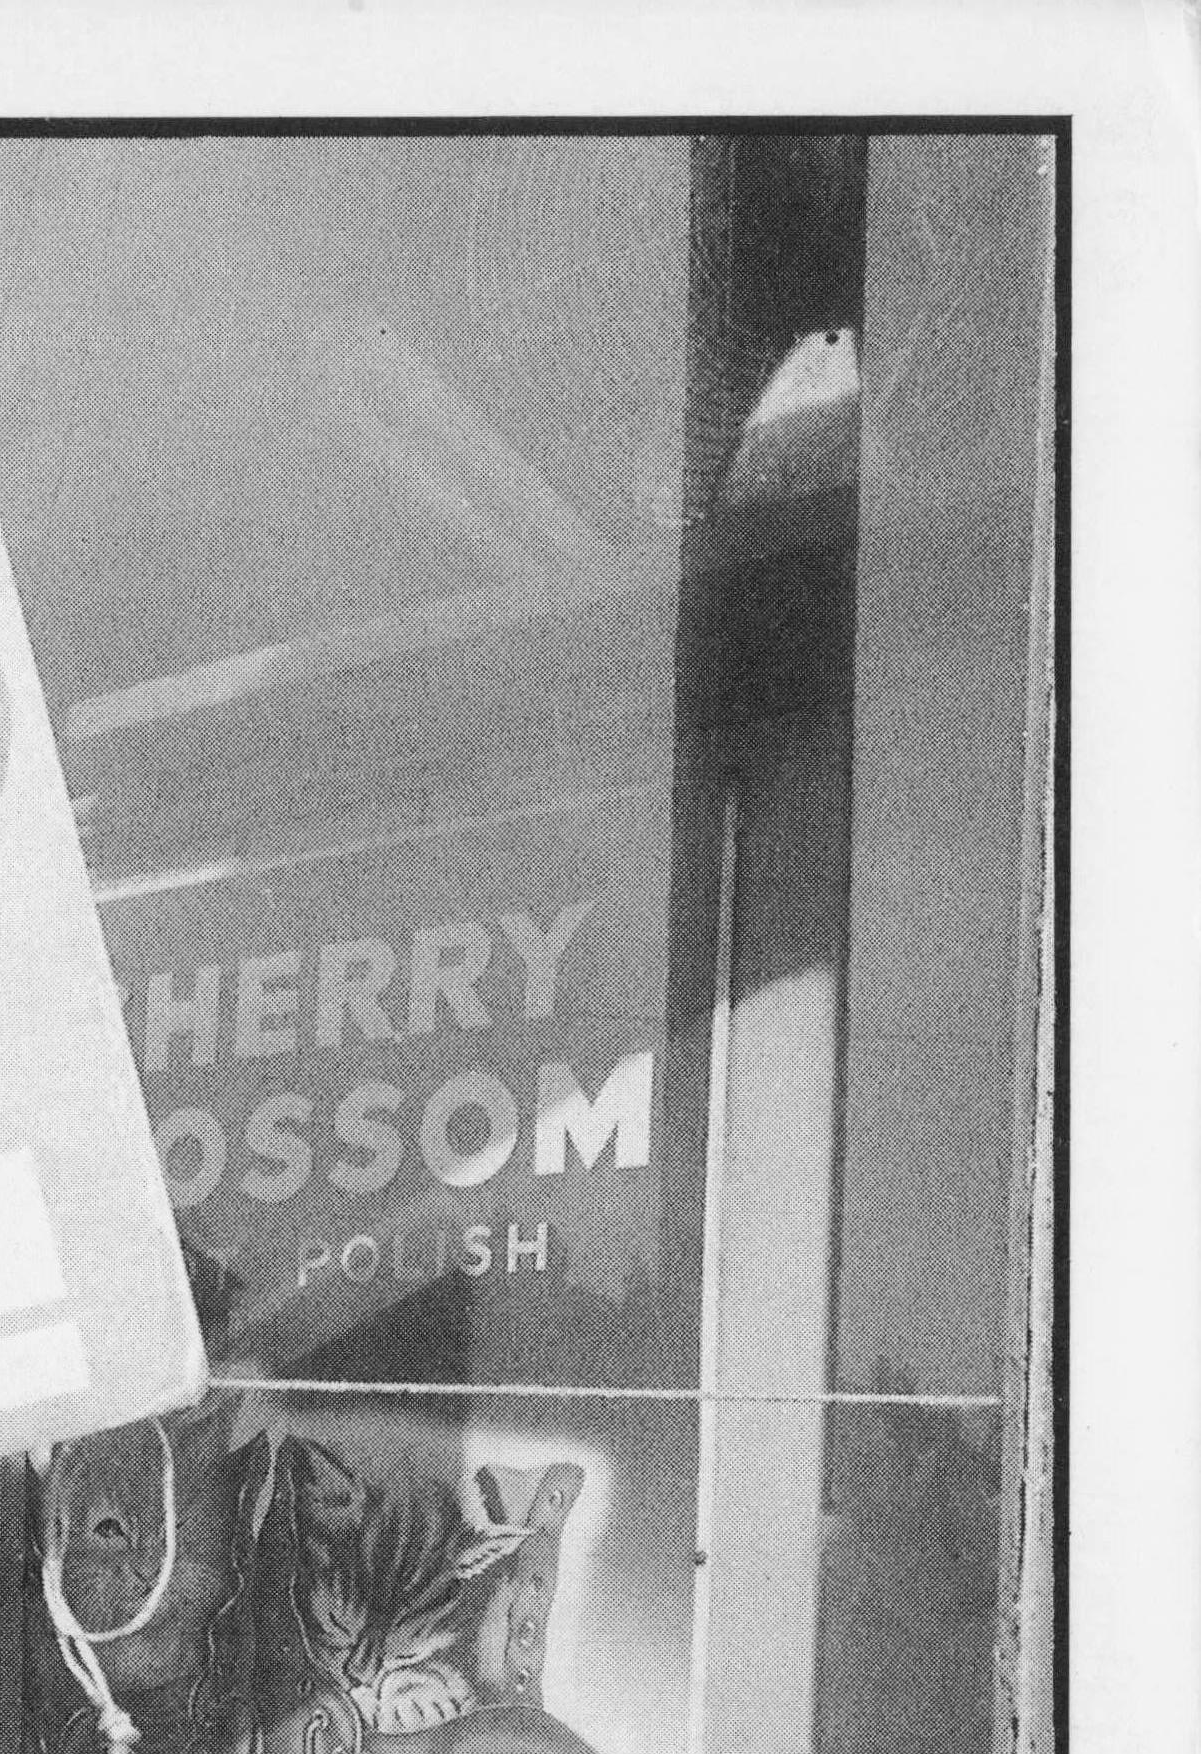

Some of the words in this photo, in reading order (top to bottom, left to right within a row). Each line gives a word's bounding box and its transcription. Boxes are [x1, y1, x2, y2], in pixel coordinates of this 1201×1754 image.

[119, 900, 597, 1072] HERRY
[155, 1052, 653, 1207] OSSOM
[298, 1222, 549, 1288] POLISH
